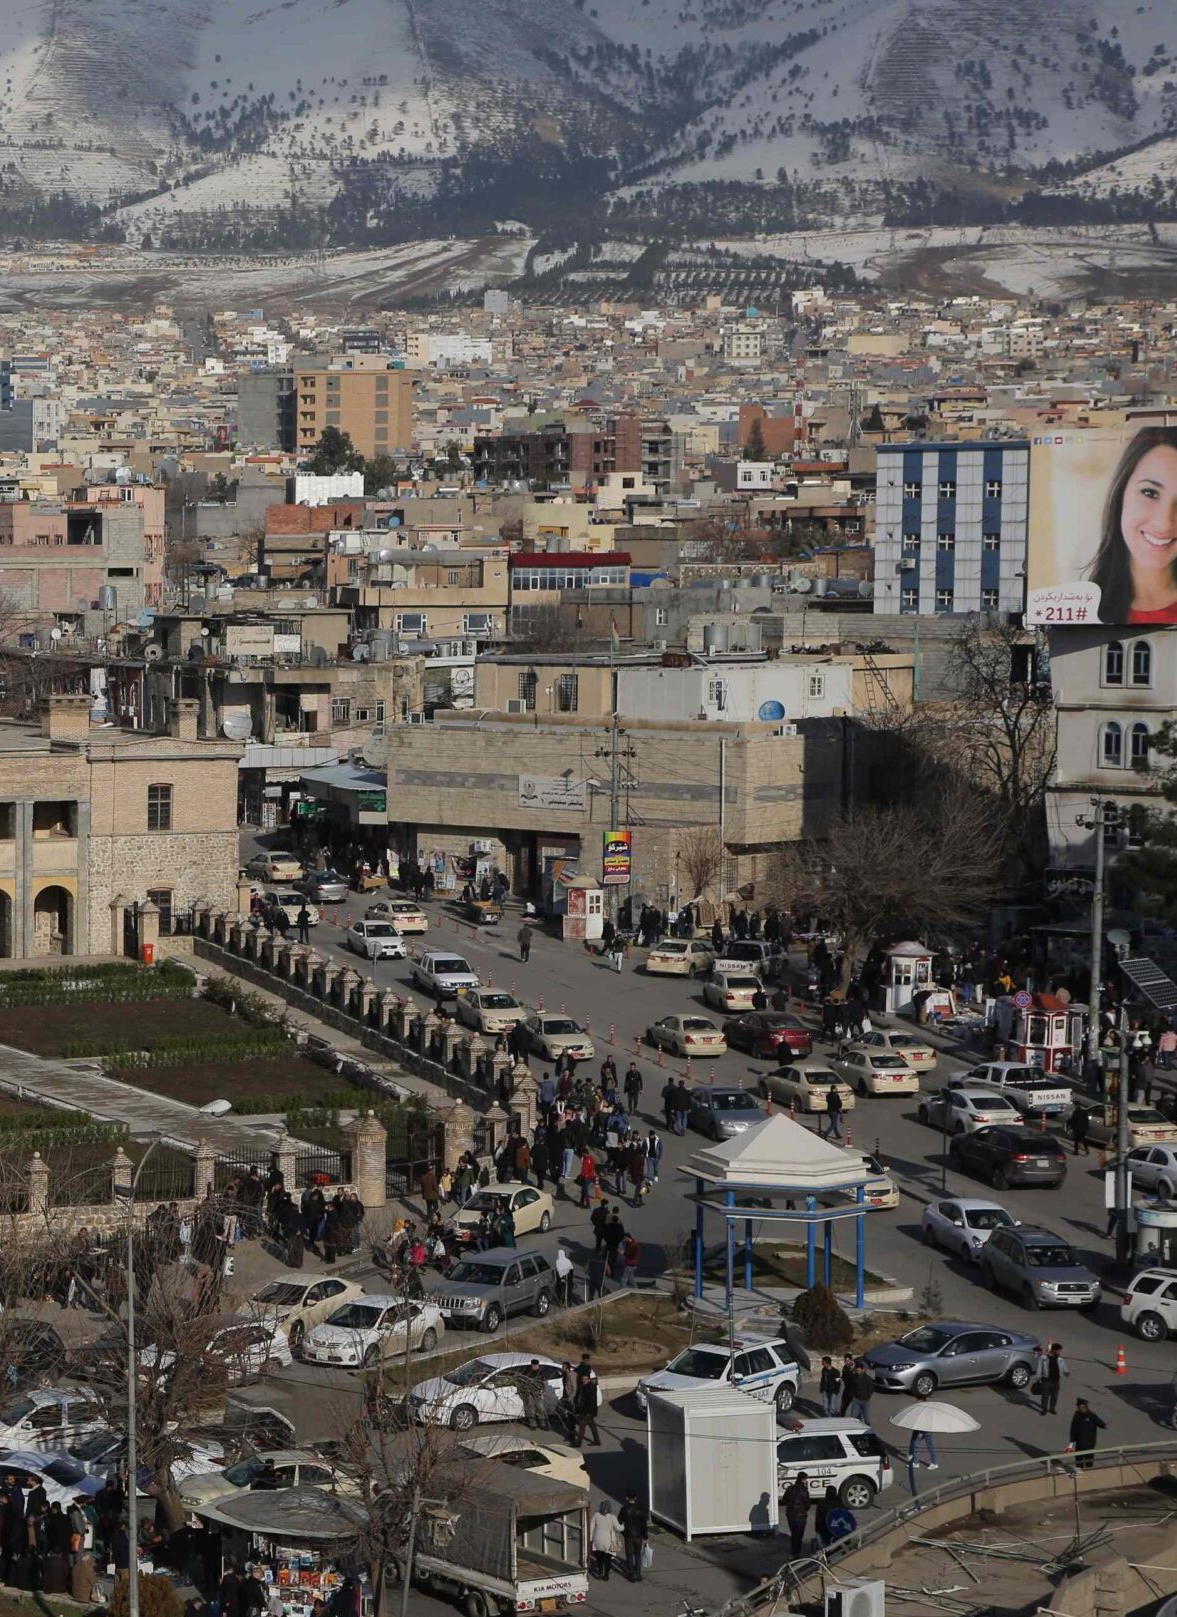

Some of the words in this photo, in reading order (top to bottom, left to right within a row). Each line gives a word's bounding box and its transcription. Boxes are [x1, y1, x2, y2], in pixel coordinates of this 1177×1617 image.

[719, 962, 746, 970] NISSAN
[1037, 1093, 1066, 1101] NISSAN
[816, 1467, 832, 1476] 104
[546, 1582, 572, 1591] MOTORS
